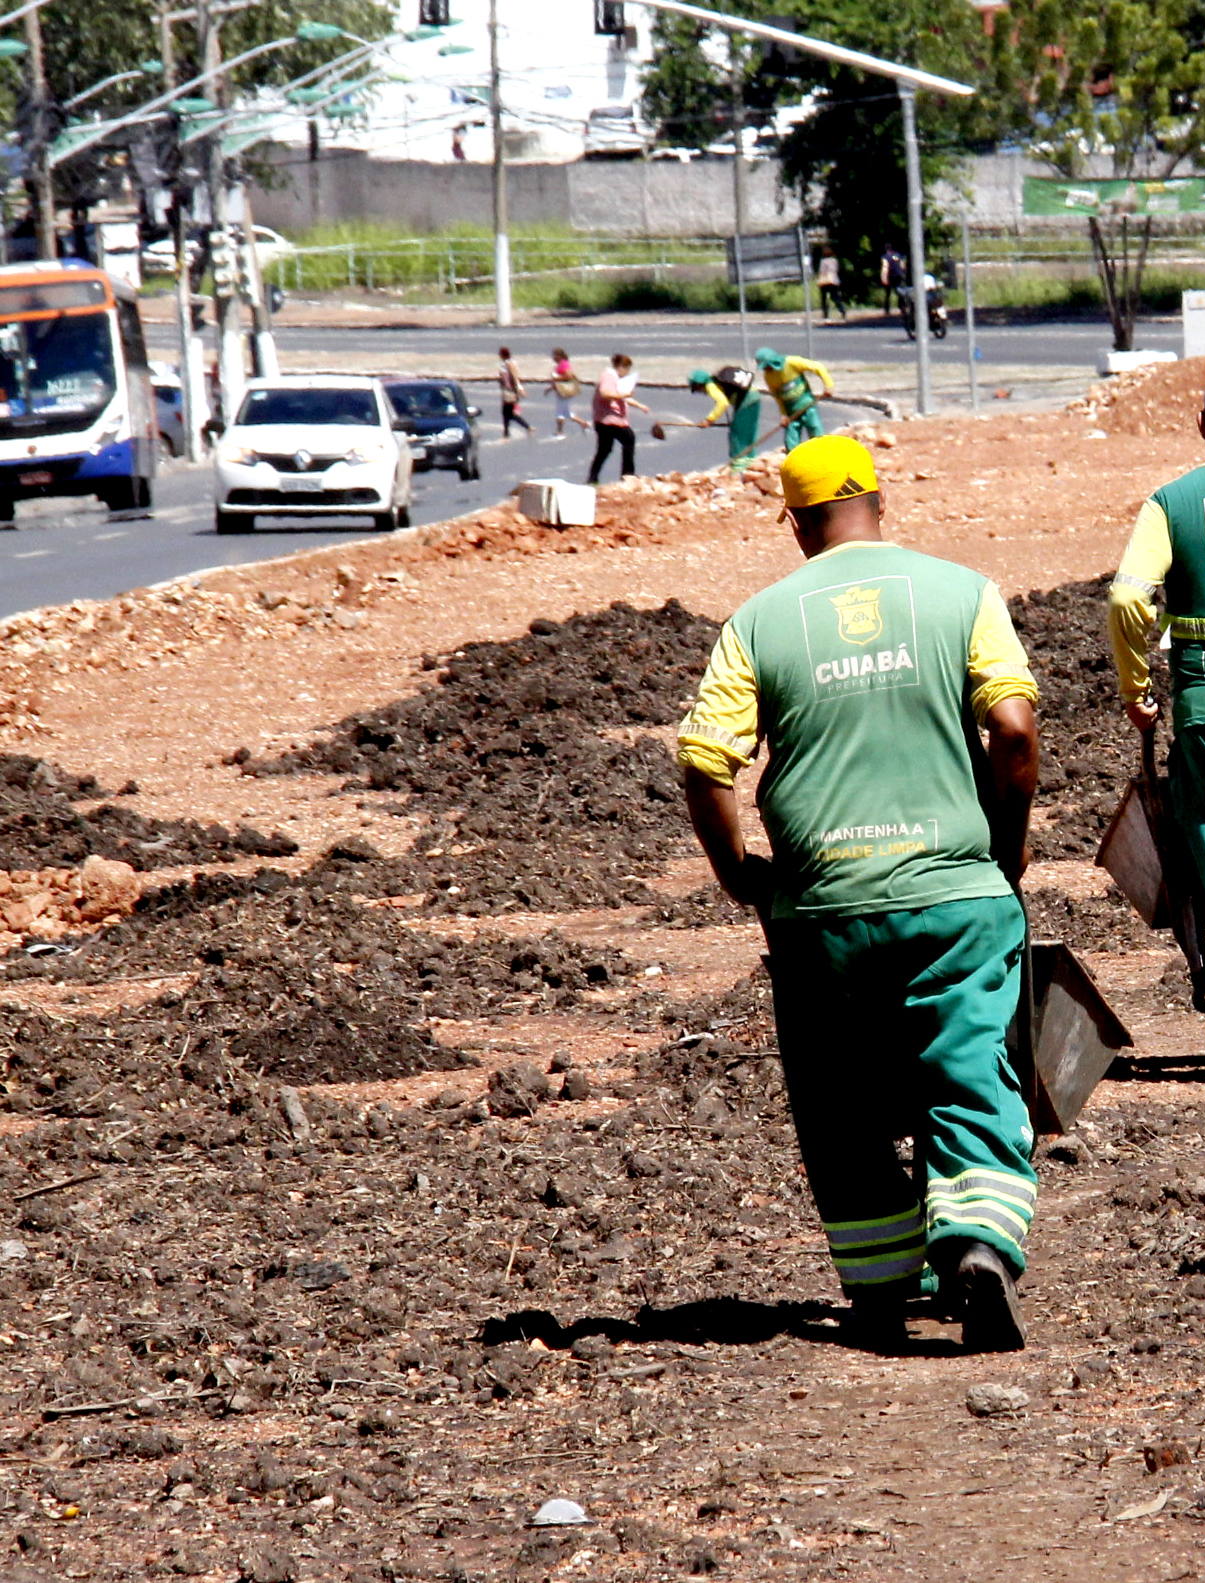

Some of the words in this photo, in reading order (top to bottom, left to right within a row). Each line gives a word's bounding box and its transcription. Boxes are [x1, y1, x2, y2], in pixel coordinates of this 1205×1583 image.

[815, 642, 914, 684] CUIABÁ
[820, 823, 909, 843] MANTENHA
[912, 822, 925, 835] A
[816, 844, 875, 861] CIDADE
[878, 841, 926, 857] LIMPA
